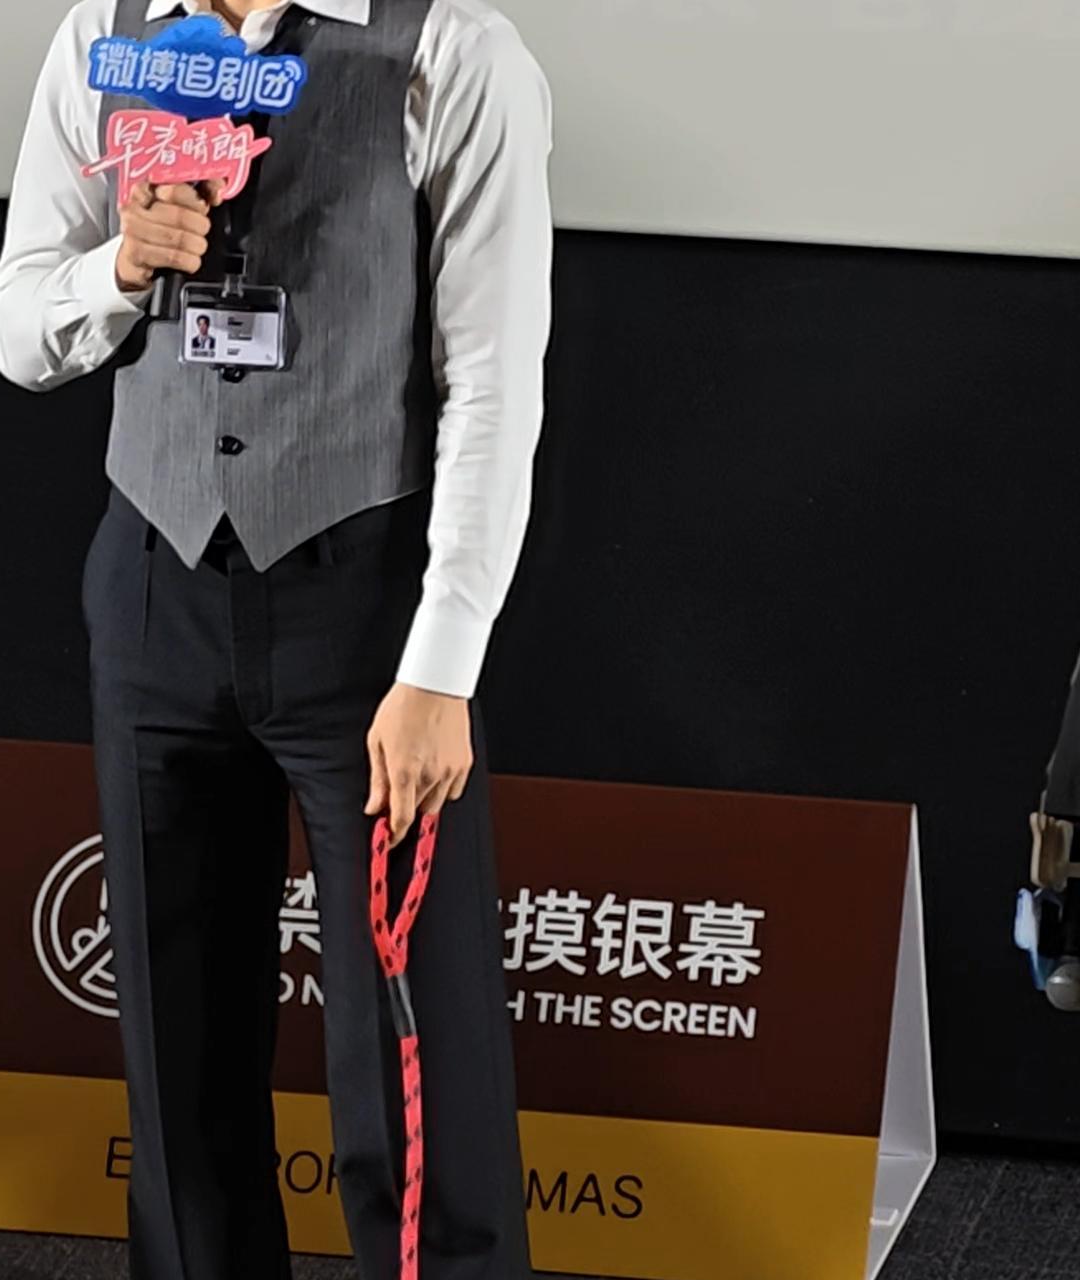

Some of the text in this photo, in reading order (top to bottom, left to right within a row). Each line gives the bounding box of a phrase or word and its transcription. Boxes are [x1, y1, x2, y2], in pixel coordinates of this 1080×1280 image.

[96, 42, 302, 108] 微博追剧团
[533, 991, 604, 1027] THE
[610, 997, 758, 1040] SCREEN
